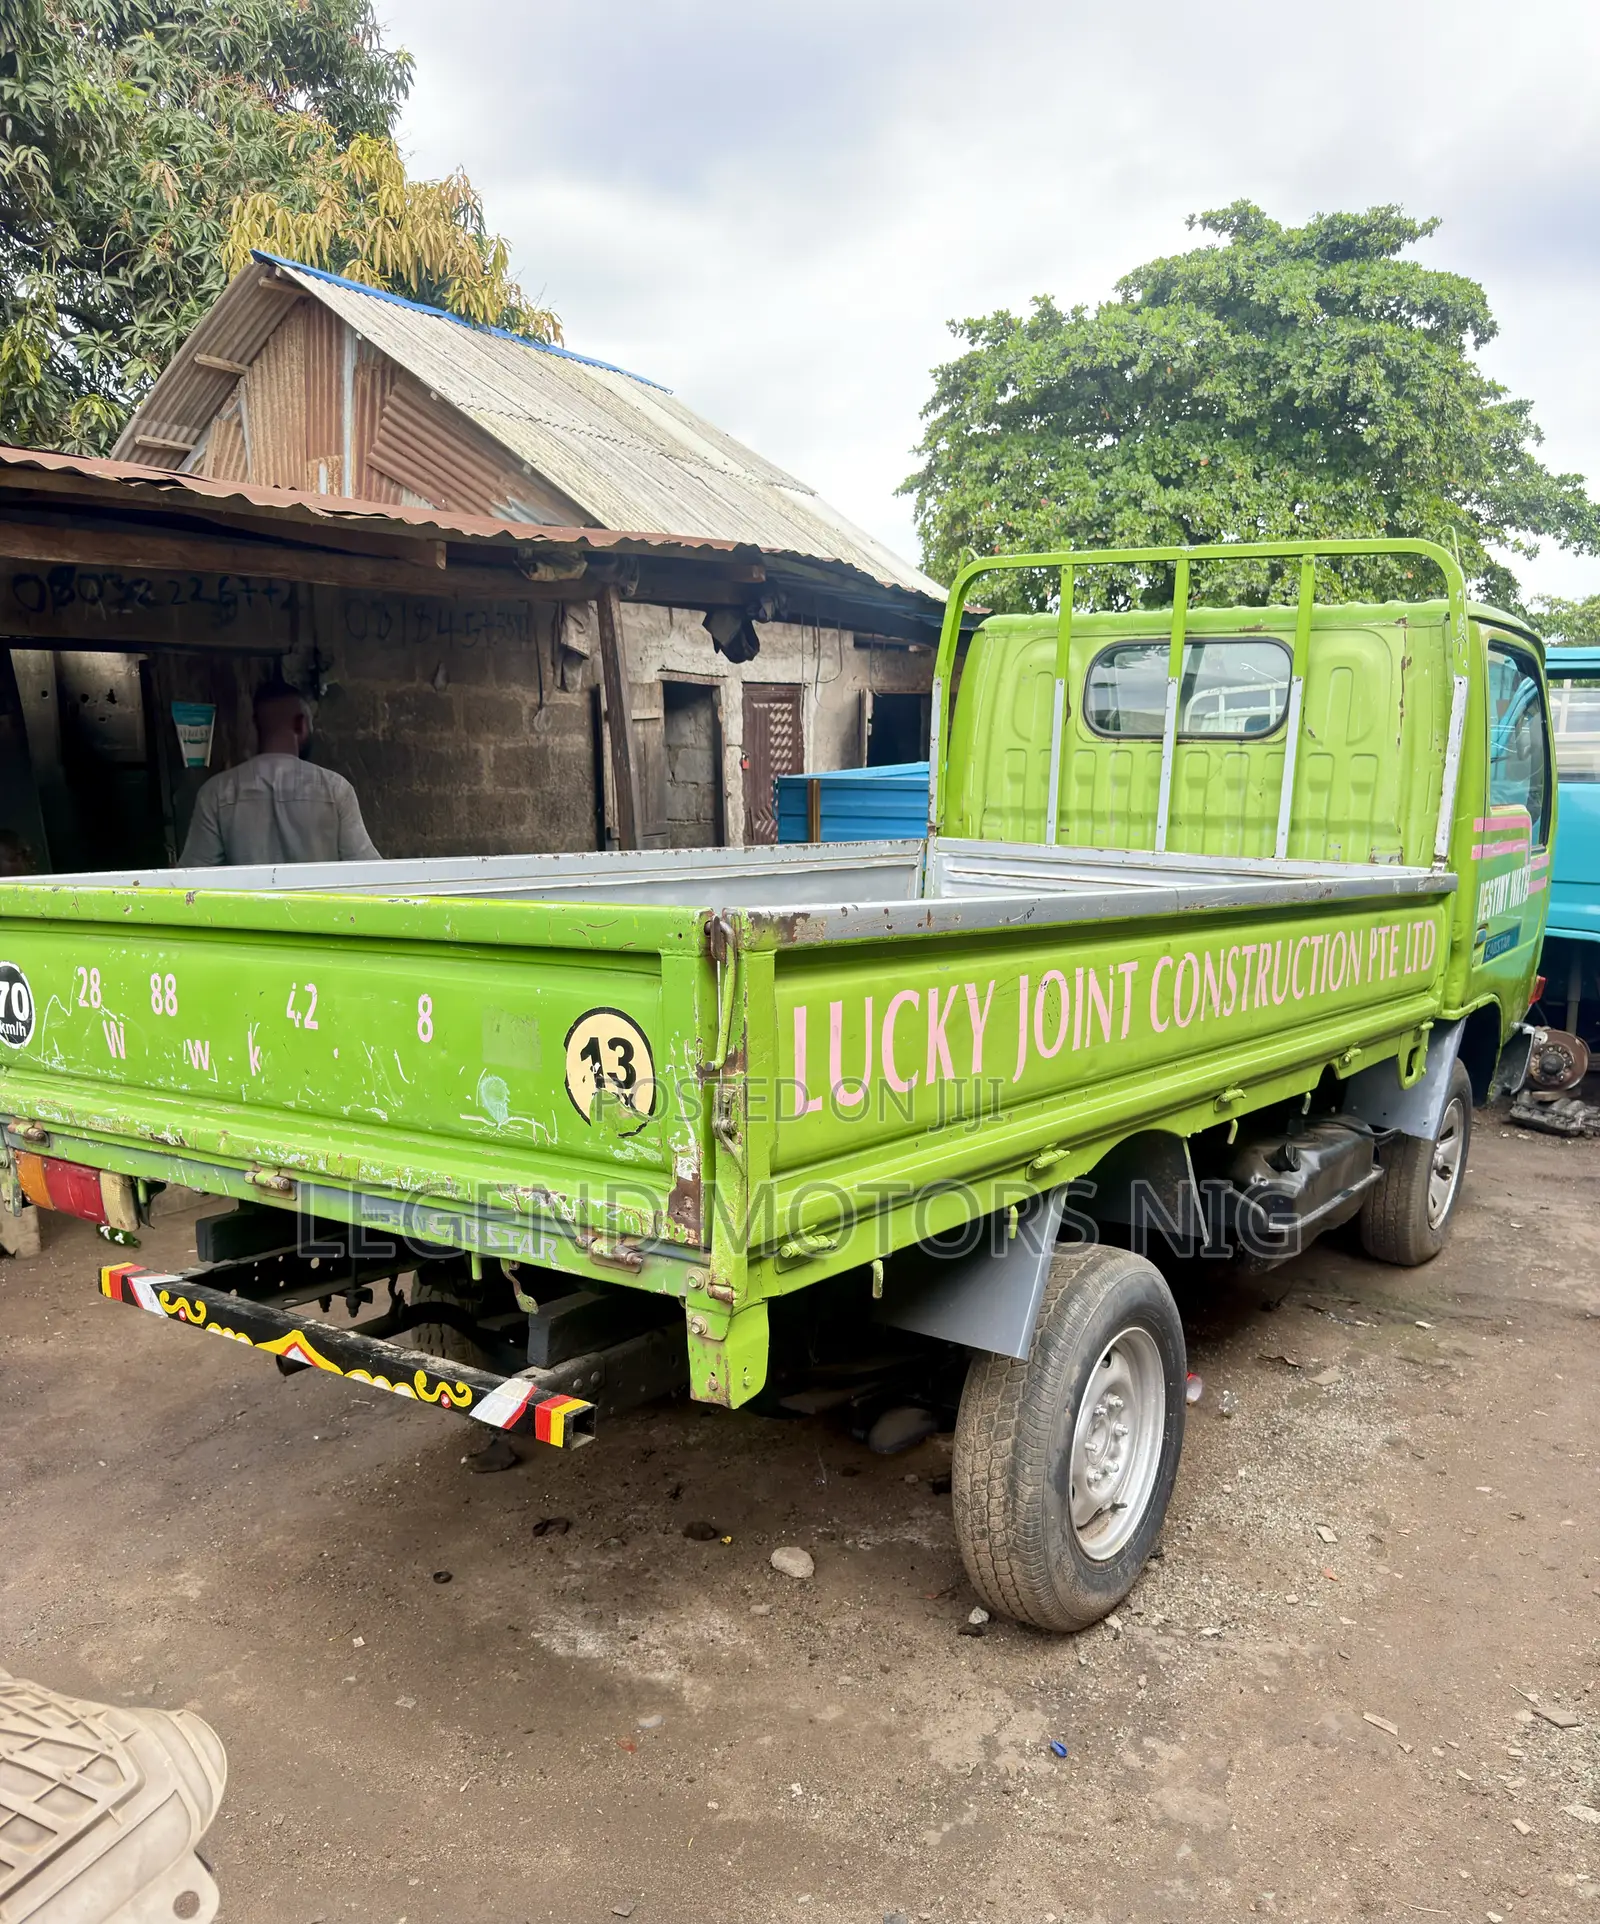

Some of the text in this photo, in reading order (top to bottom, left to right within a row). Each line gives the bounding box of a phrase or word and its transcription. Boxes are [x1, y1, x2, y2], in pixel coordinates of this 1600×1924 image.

[1477, 872, 1511, 923] DESTINY
[0, 981, 30, 1021] 70
[78, 966, 102, 1008] 28
[150, 973, 178, 1017] 88
[417, 994, 434, 1043] 8
[794, 920, 1436, 1116] LUCKY JOINT CONSTRUCTION PTE LTD
[580, 1036, 637, 1090] 13
[361, 1205, 428, 1233] NISSAN
[429, 1212, 559, 1264] CABSTAR
